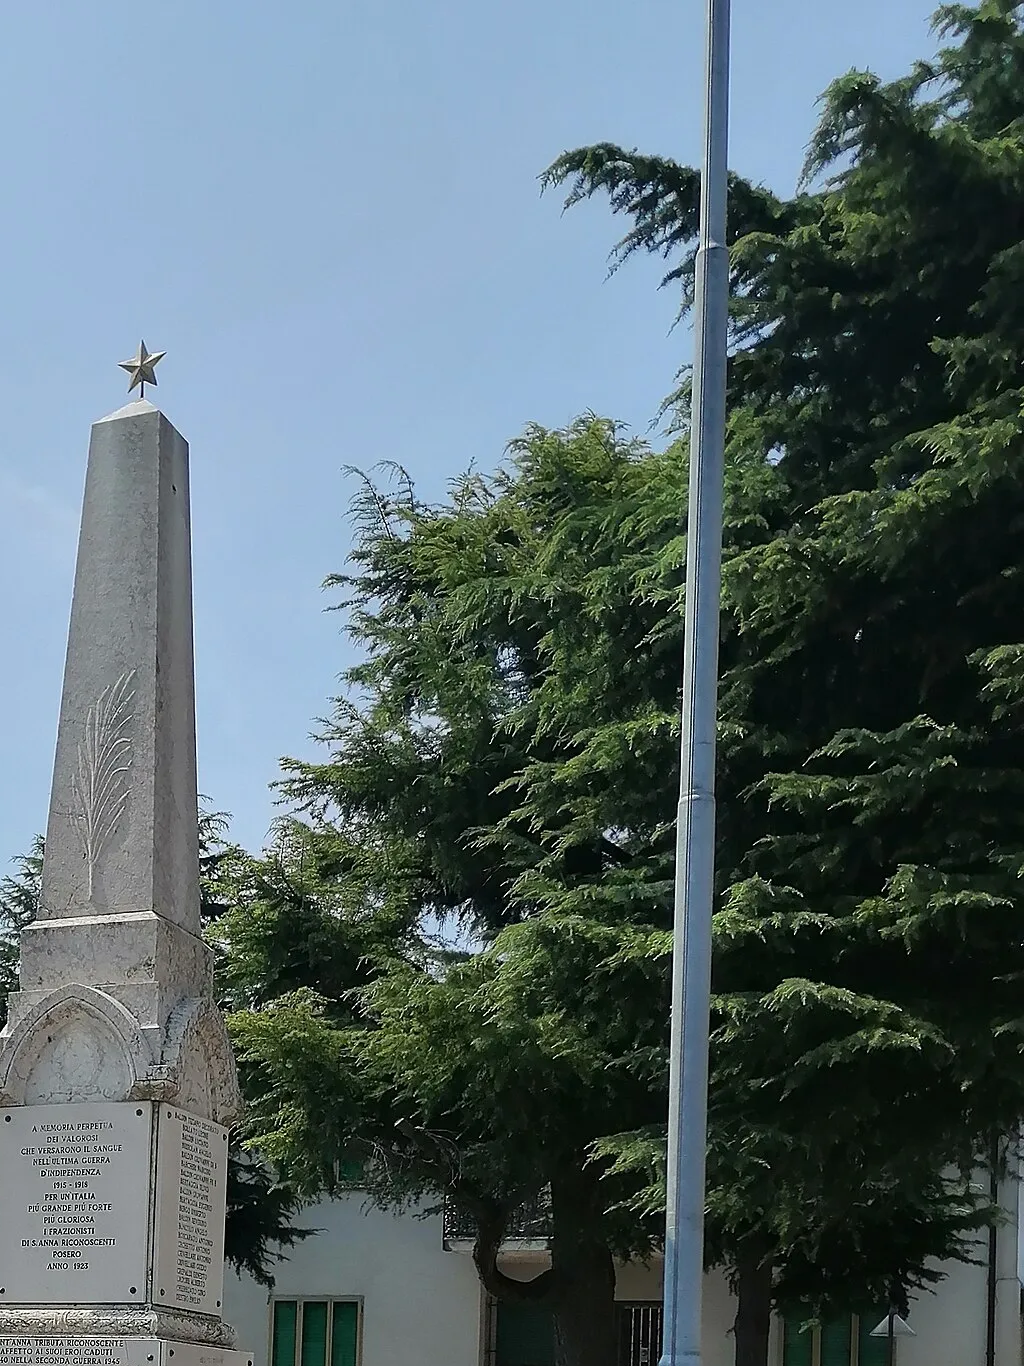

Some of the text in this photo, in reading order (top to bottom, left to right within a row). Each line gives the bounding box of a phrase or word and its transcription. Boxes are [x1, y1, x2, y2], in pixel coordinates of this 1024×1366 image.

[40, 1124, 74, 1132] MEMORIA
[77, 1122, 113, 1131] PERPETUA
[62, 1135, 98, 1143] VALOROSI
[21, 1147, 35, 1155] CHE
[38, 1146, 82, 1154] VERSARONO
[41, 1169, 101, 1177] D'INDIPENDENZA
[60, 1192, 96, 1200] UN'ITALIA
[42, 1204, 72, 1212] GRANDE
[88, 1203, 112, 1211] FORTE
[67, 1340, 124, 1348] RICONOSCENTE
[0, 1348, 34, 1356] AFFETTO
[10, 1357, 34, 1365] NELLA
[35, 1357, 71, 1365] SECONDA
[73, 1357, 103, 1365] GUERRA
[104, 1357, 120, 1365] 1945
